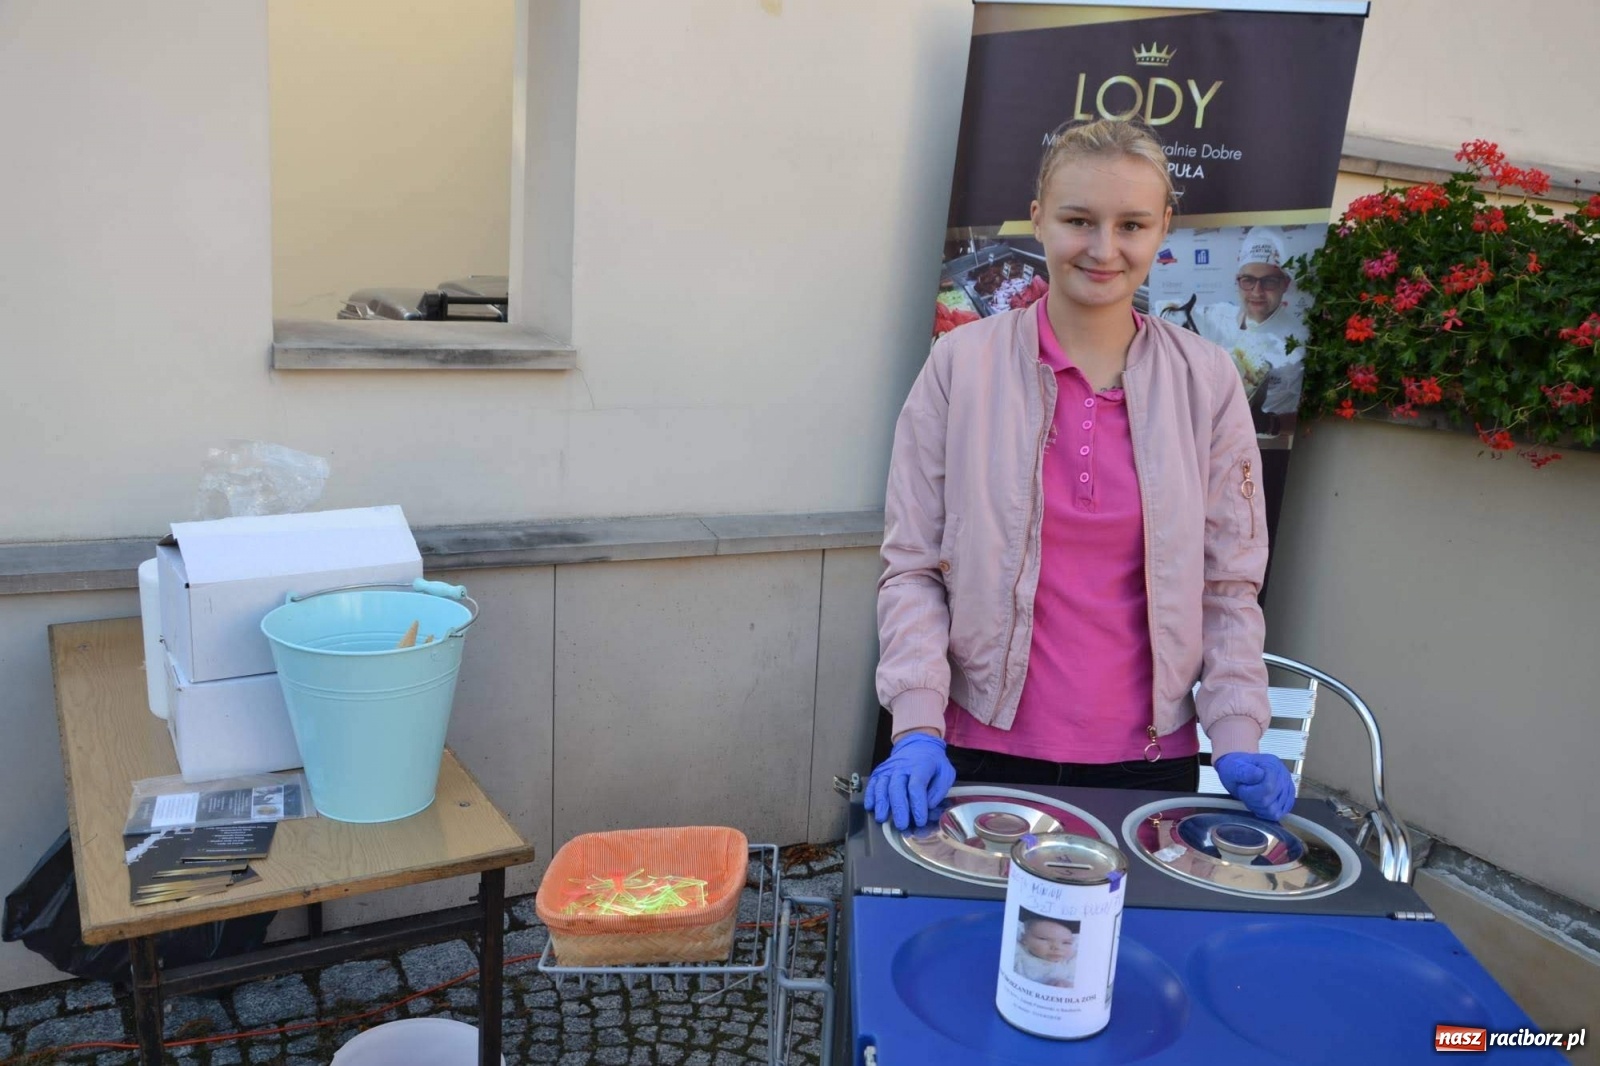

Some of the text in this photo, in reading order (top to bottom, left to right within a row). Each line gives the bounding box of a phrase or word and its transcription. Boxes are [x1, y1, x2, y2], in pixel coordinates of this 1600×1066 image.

[1073, 73, 1223, 129] LODY
[1201, 144, 1243, 160] Dobre
[1034, 992, 1064, 1004] RAZEM
